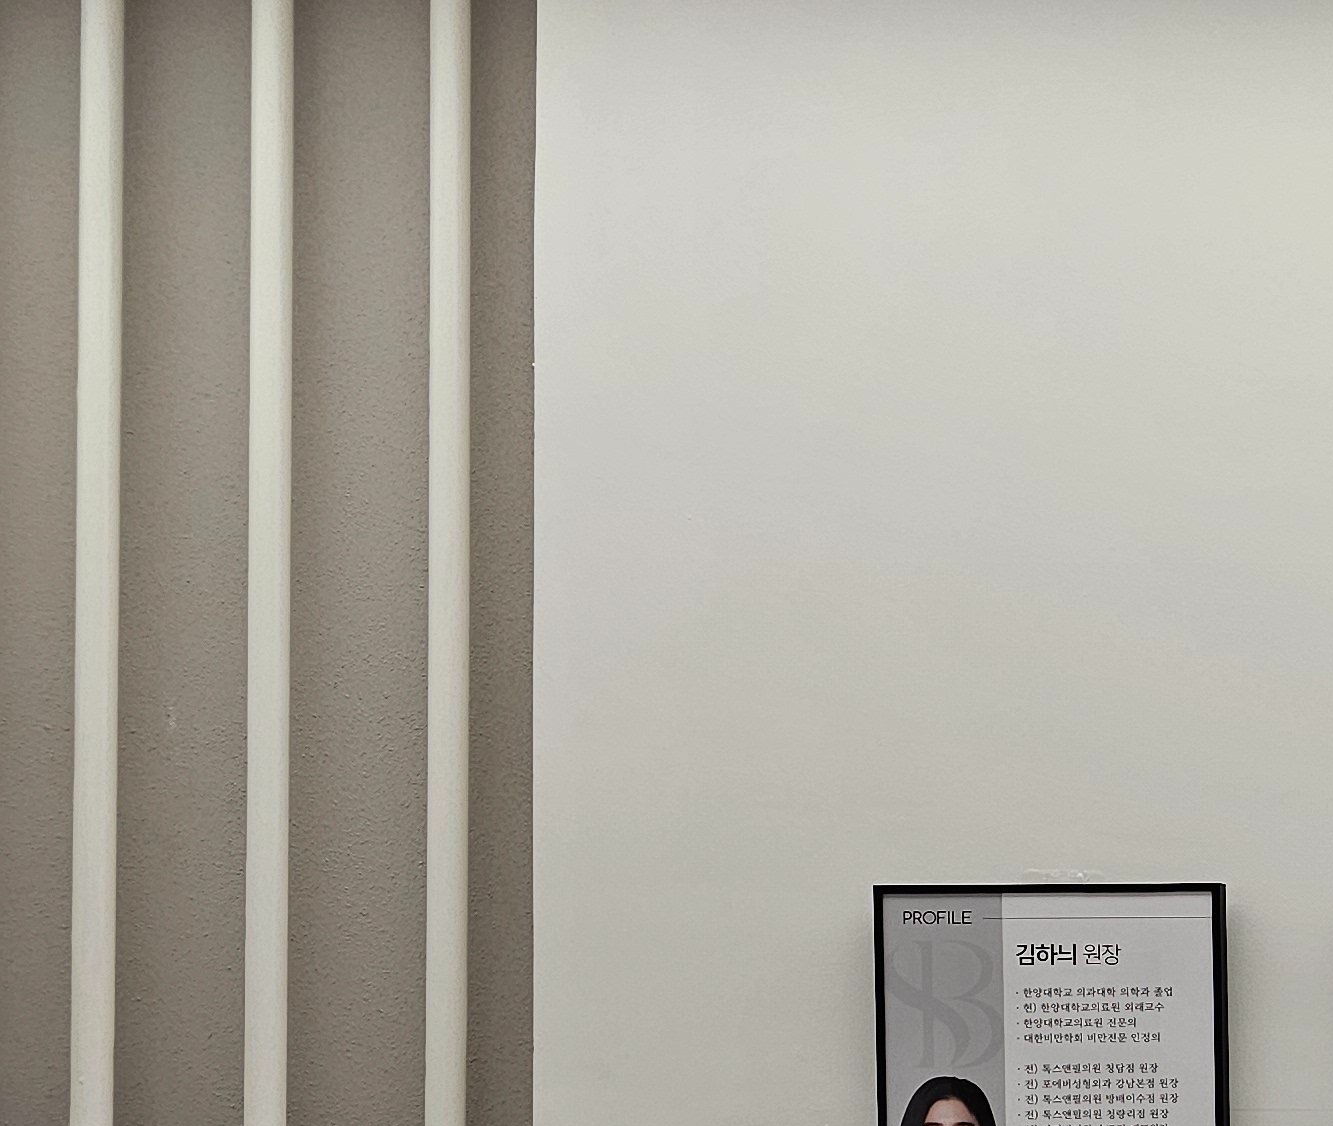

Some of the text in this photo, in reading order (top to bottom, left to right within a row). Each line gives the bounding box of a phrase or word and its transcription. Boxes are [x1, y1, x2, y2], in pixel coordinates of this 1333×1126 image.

[903, 911, 972, 924] PROFILE
[1016, 944, 1122, 965] 김하늬 원장
